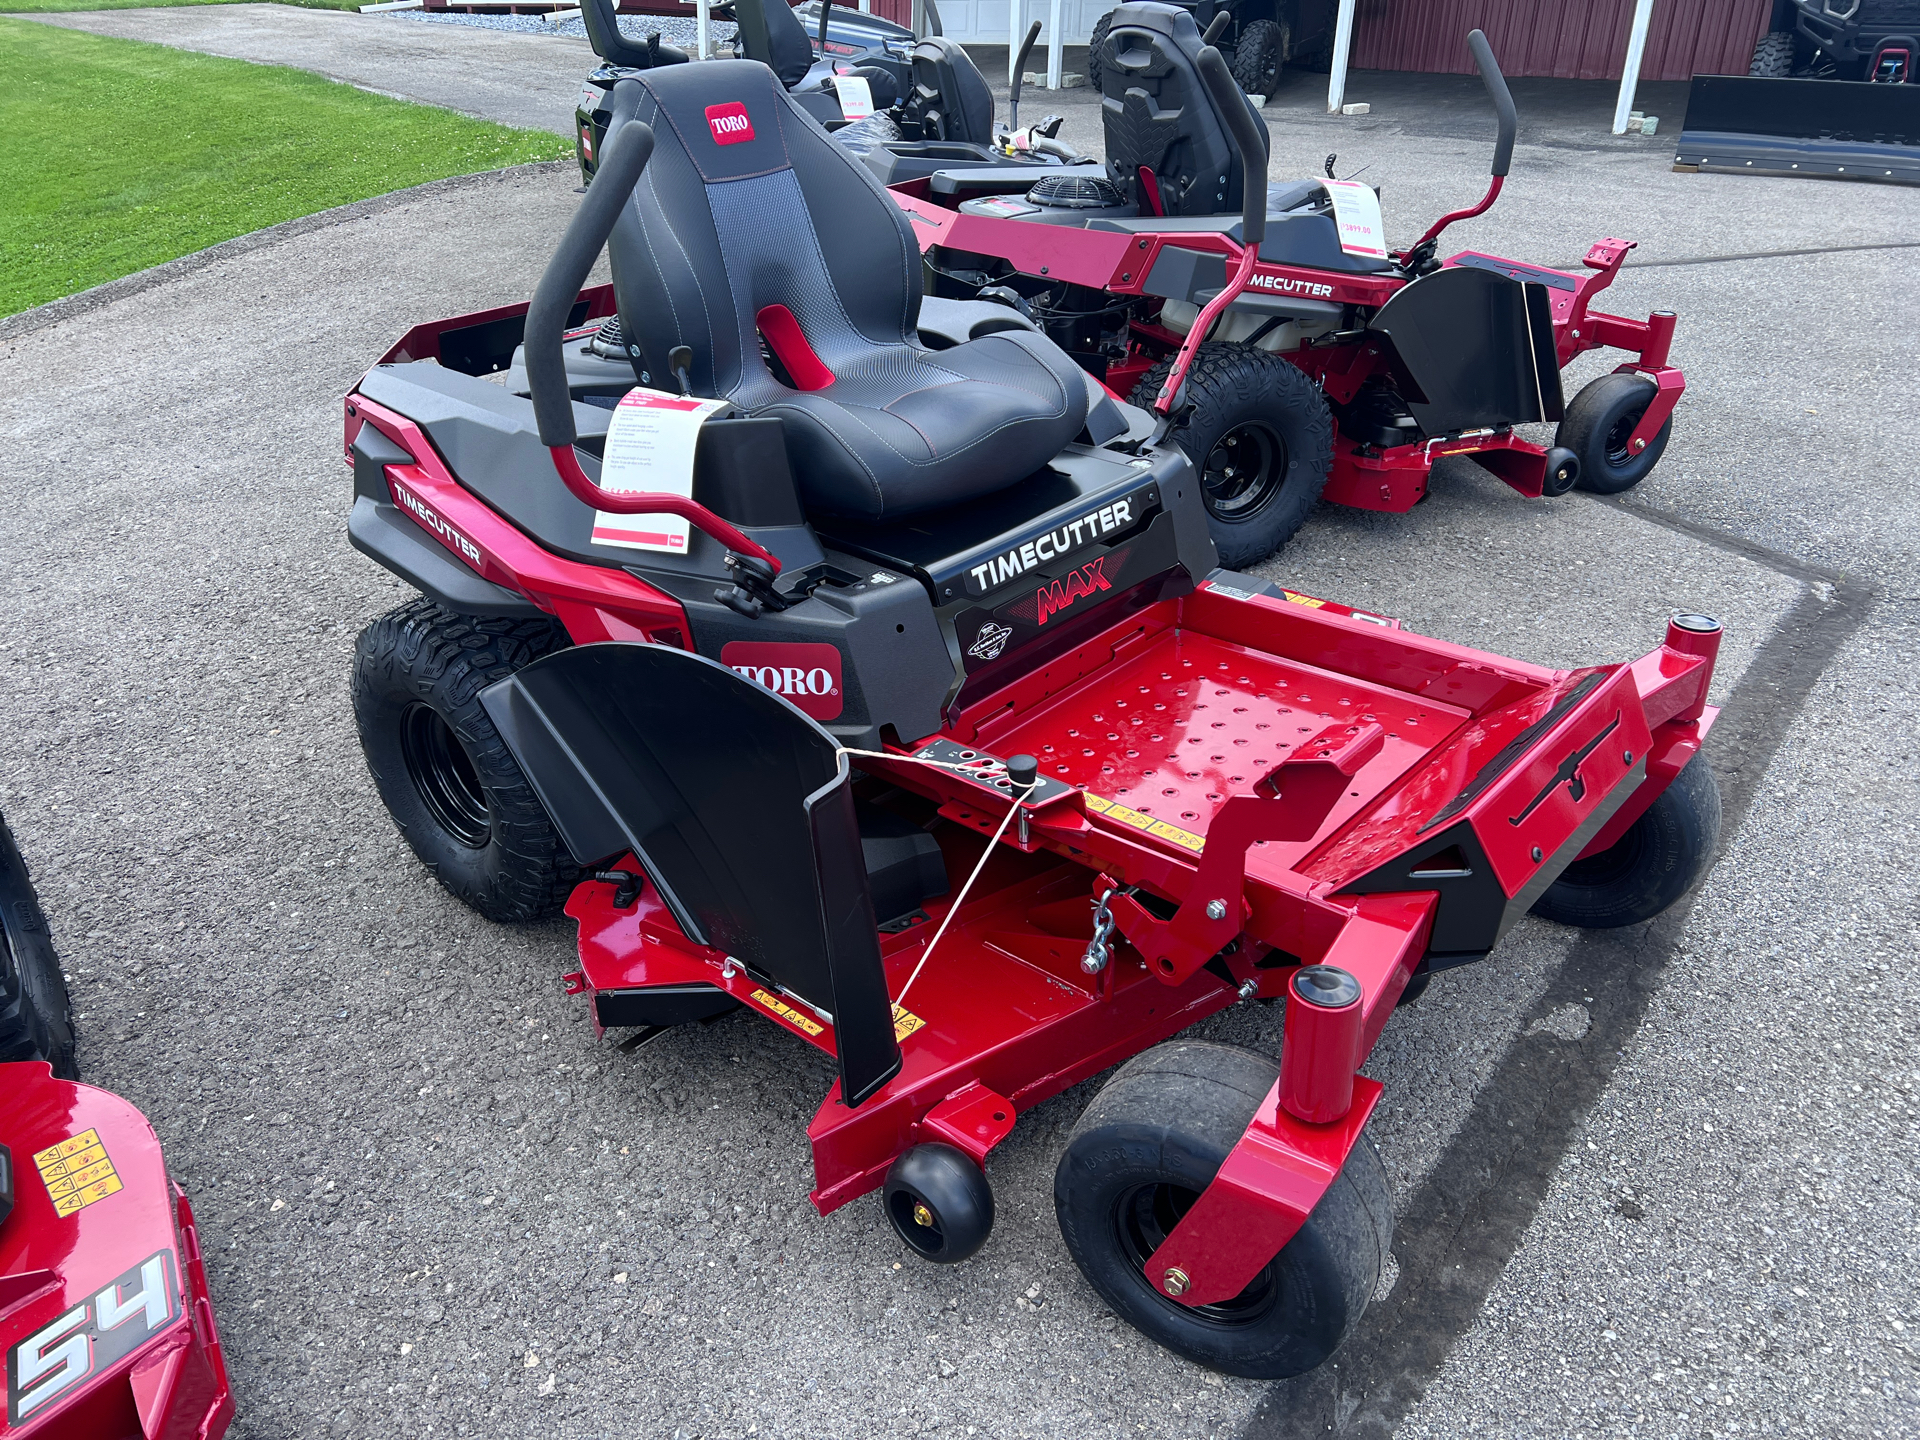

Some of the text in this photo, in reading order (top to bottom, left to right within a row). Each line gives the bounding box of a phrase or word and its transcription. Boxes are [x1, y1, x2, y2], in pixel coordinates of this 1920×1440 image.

[814, 40, 854, 54] TOY-BILT
[711, 114, 748, 134] TORO
[1246, 273, 1333, 297] MECUTTER
[394, 482, 481, 566] TIMECUTTER
[971, 498, 1132, 591] TIMECUTTER
[1037, 556, 1112, 626] MAX
[17, 1254, 169, 1419] 54
